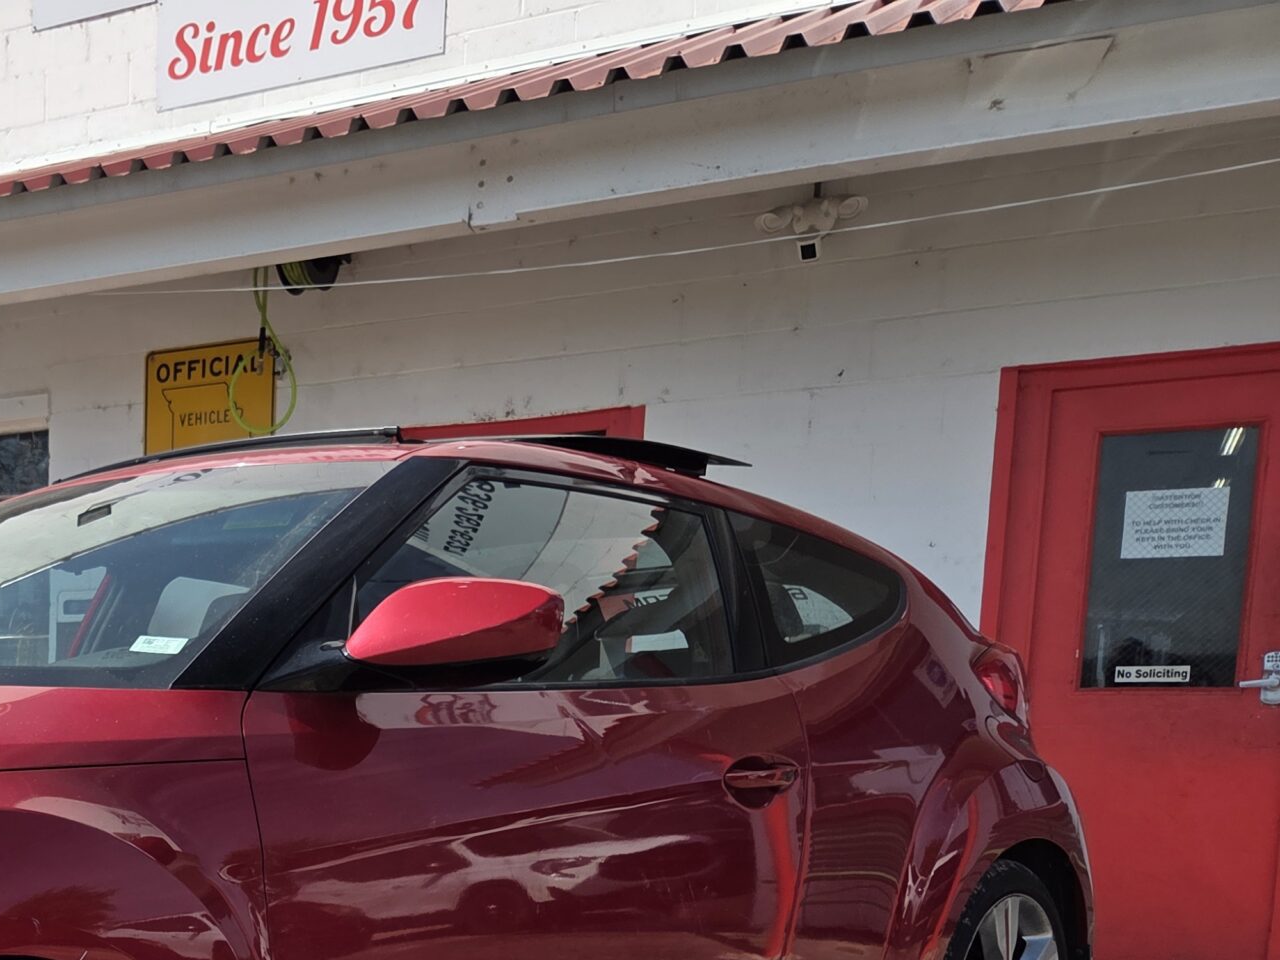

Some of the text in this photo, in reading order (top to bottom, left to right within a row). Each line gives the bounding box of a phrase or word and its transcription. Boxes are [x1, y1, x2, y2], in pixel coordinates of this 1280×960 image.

[167, 19, 296, 80] Since
[179, 409, 231, 428] VEHICLE
[1117, 668, 1188, 680] No Soliciting
